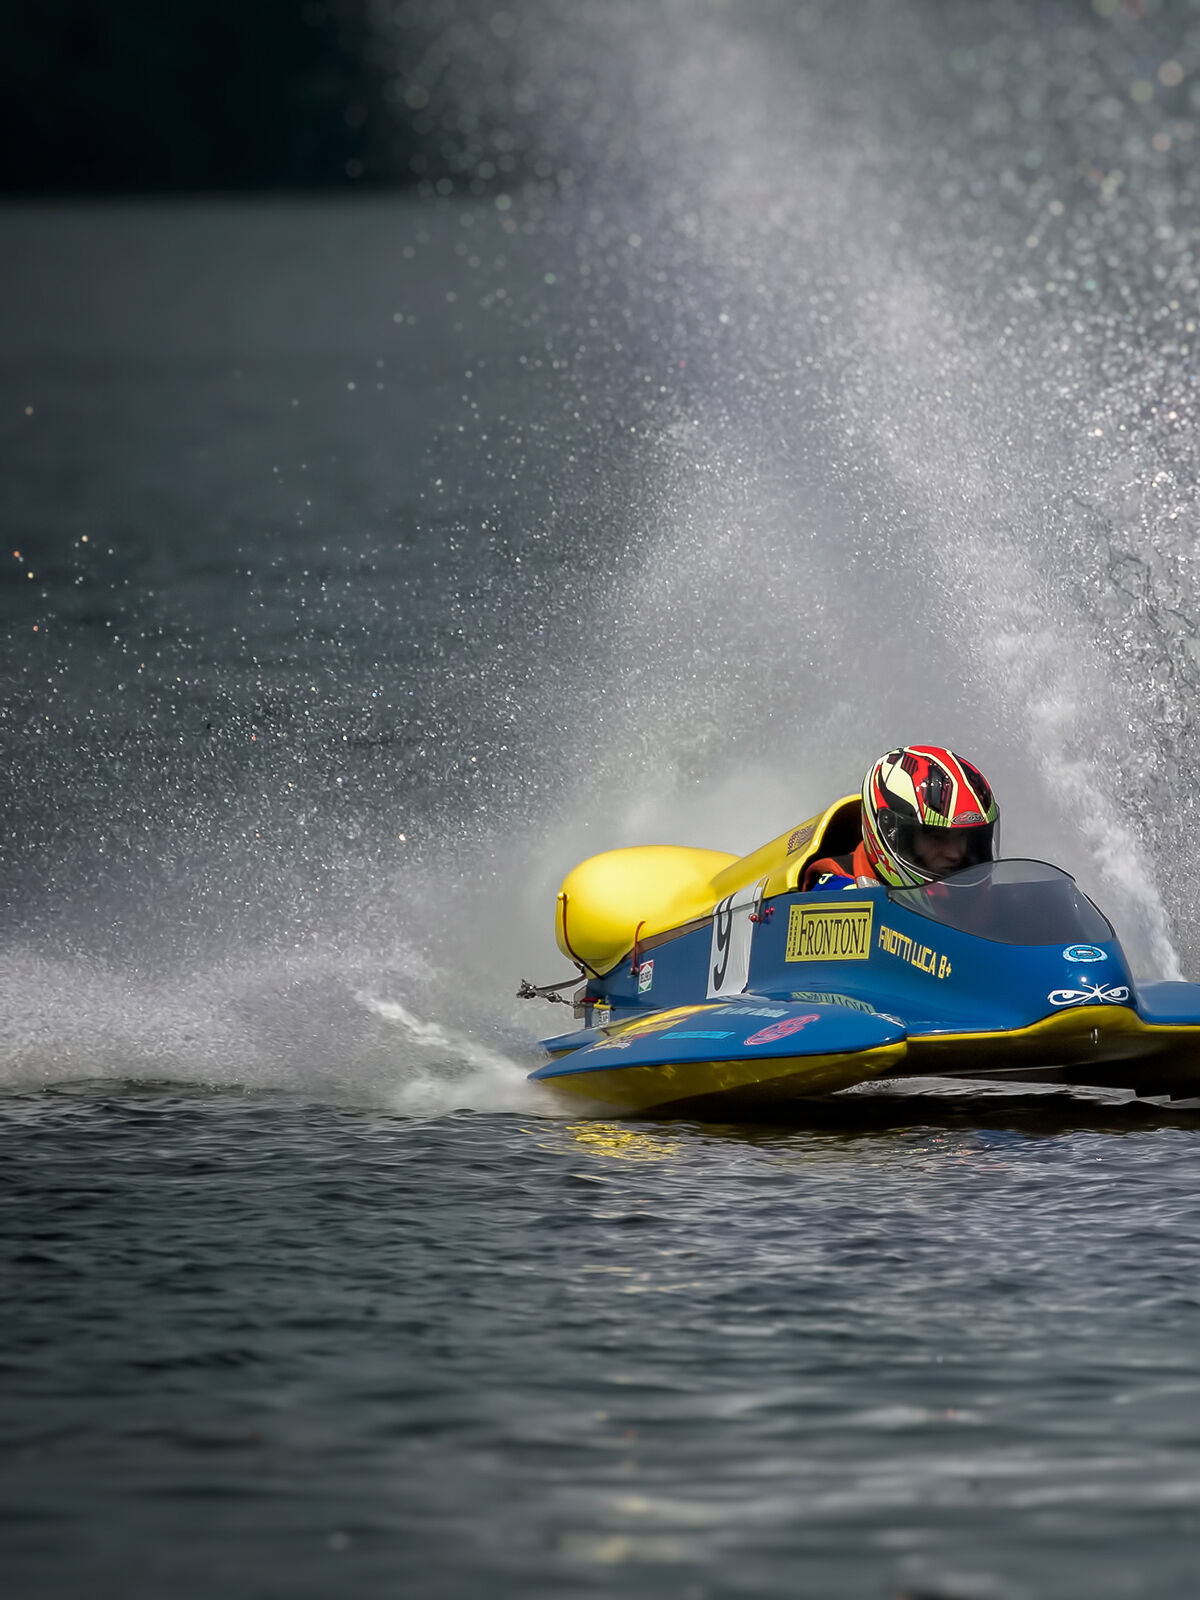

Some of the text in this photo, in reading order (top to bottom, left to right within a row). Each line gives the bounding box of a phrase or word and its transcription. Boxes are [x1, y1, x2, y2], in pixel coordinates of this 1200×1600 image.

[713, 892, 738, 992] 9
[796, 908, 871, 956] FRONTONI
[911, 942, 937, 976] LUCA
